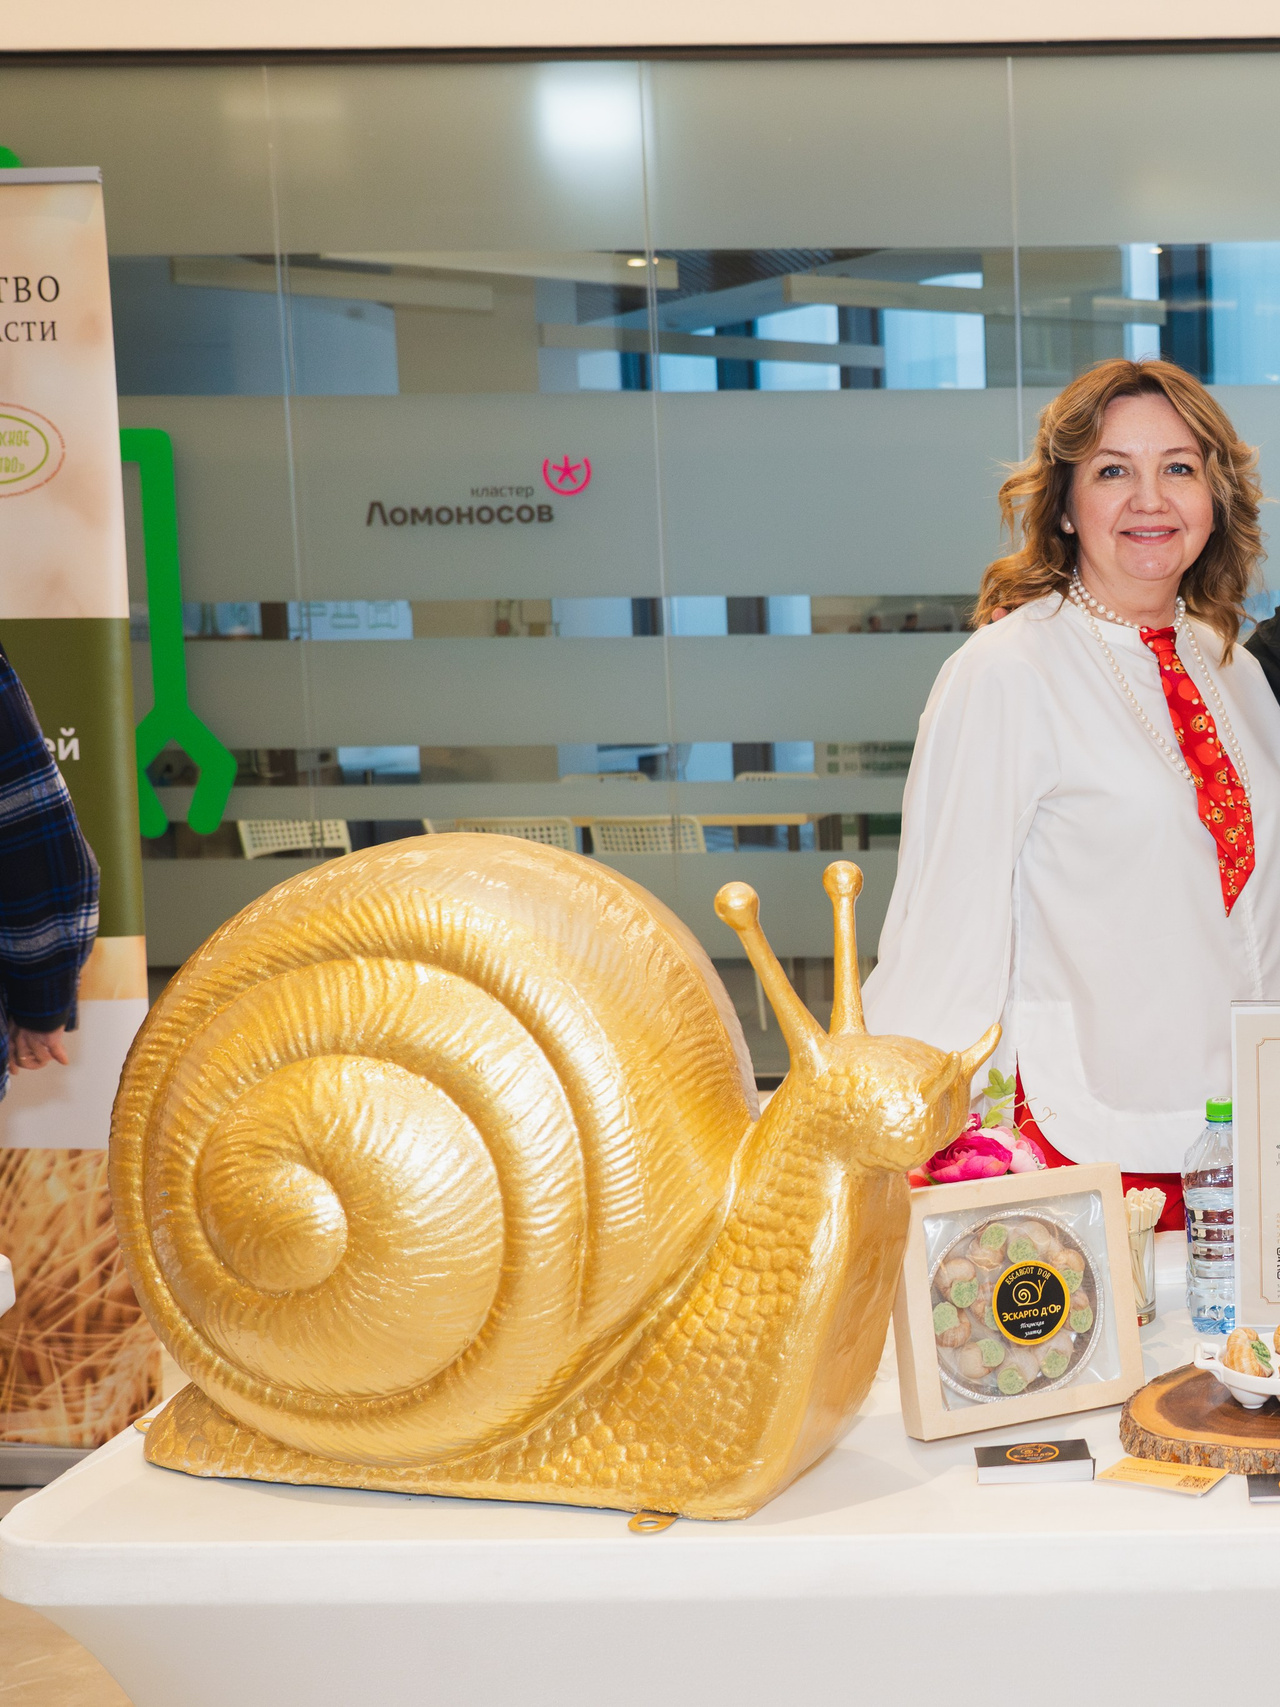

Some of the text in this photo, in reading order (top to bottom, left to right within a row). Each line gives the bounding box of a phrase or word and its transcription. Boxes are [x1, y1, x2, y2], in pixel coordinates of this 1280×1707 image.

[0, 321, 57, 342] СТИ
[470, 486, 535, 499] кластер
[366, 501, 554, 526] Ломоносов
[1005, 1267, 1035, 1286] ESCARGOT
[1002, 1304, 1062, 1322] ЭСКАРГО Д'ОР
